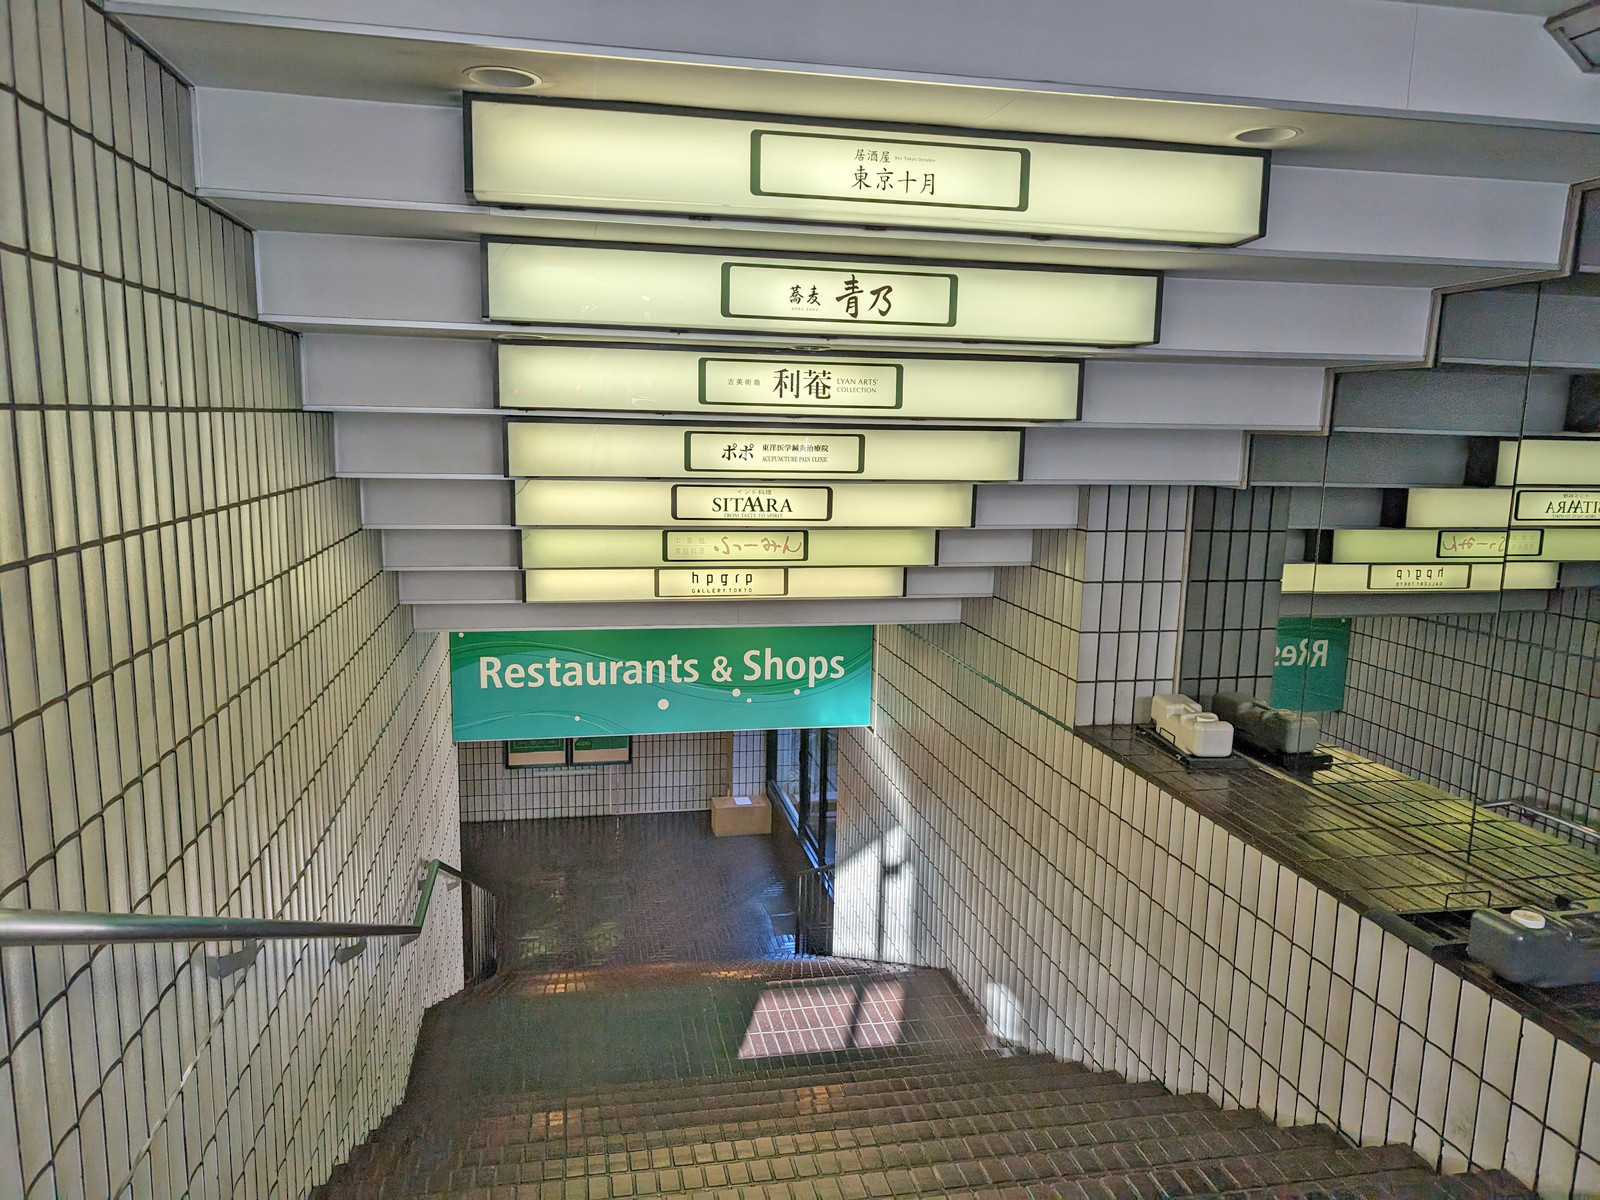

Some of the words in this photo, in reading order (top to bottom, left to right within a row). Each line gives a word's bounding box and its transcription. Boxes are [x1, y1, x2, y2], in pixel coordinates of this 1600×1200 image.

[853, 148, 891, 163] 居酒屋
[850, 165, 936, 196] 東京十月
[789, 284, 821, 306] 蕎麦
[835, 274, 893, 319] 青乃
[727, 378, 761, 387] 古美術商
[836, 386, 877, 394] COLLECTION
[721, 443, 755, 461] ポポ
[762, 443, 829, 453] 東洋医学鍼灸治療院
[711, 496, 793, 513] SITAARA
[691, 571, 753, 586] hpgrp
[479, 653, 700, 689] Restaurants
[711, 656, 734, 682] &
[743, 647, 845, 687] Shops
